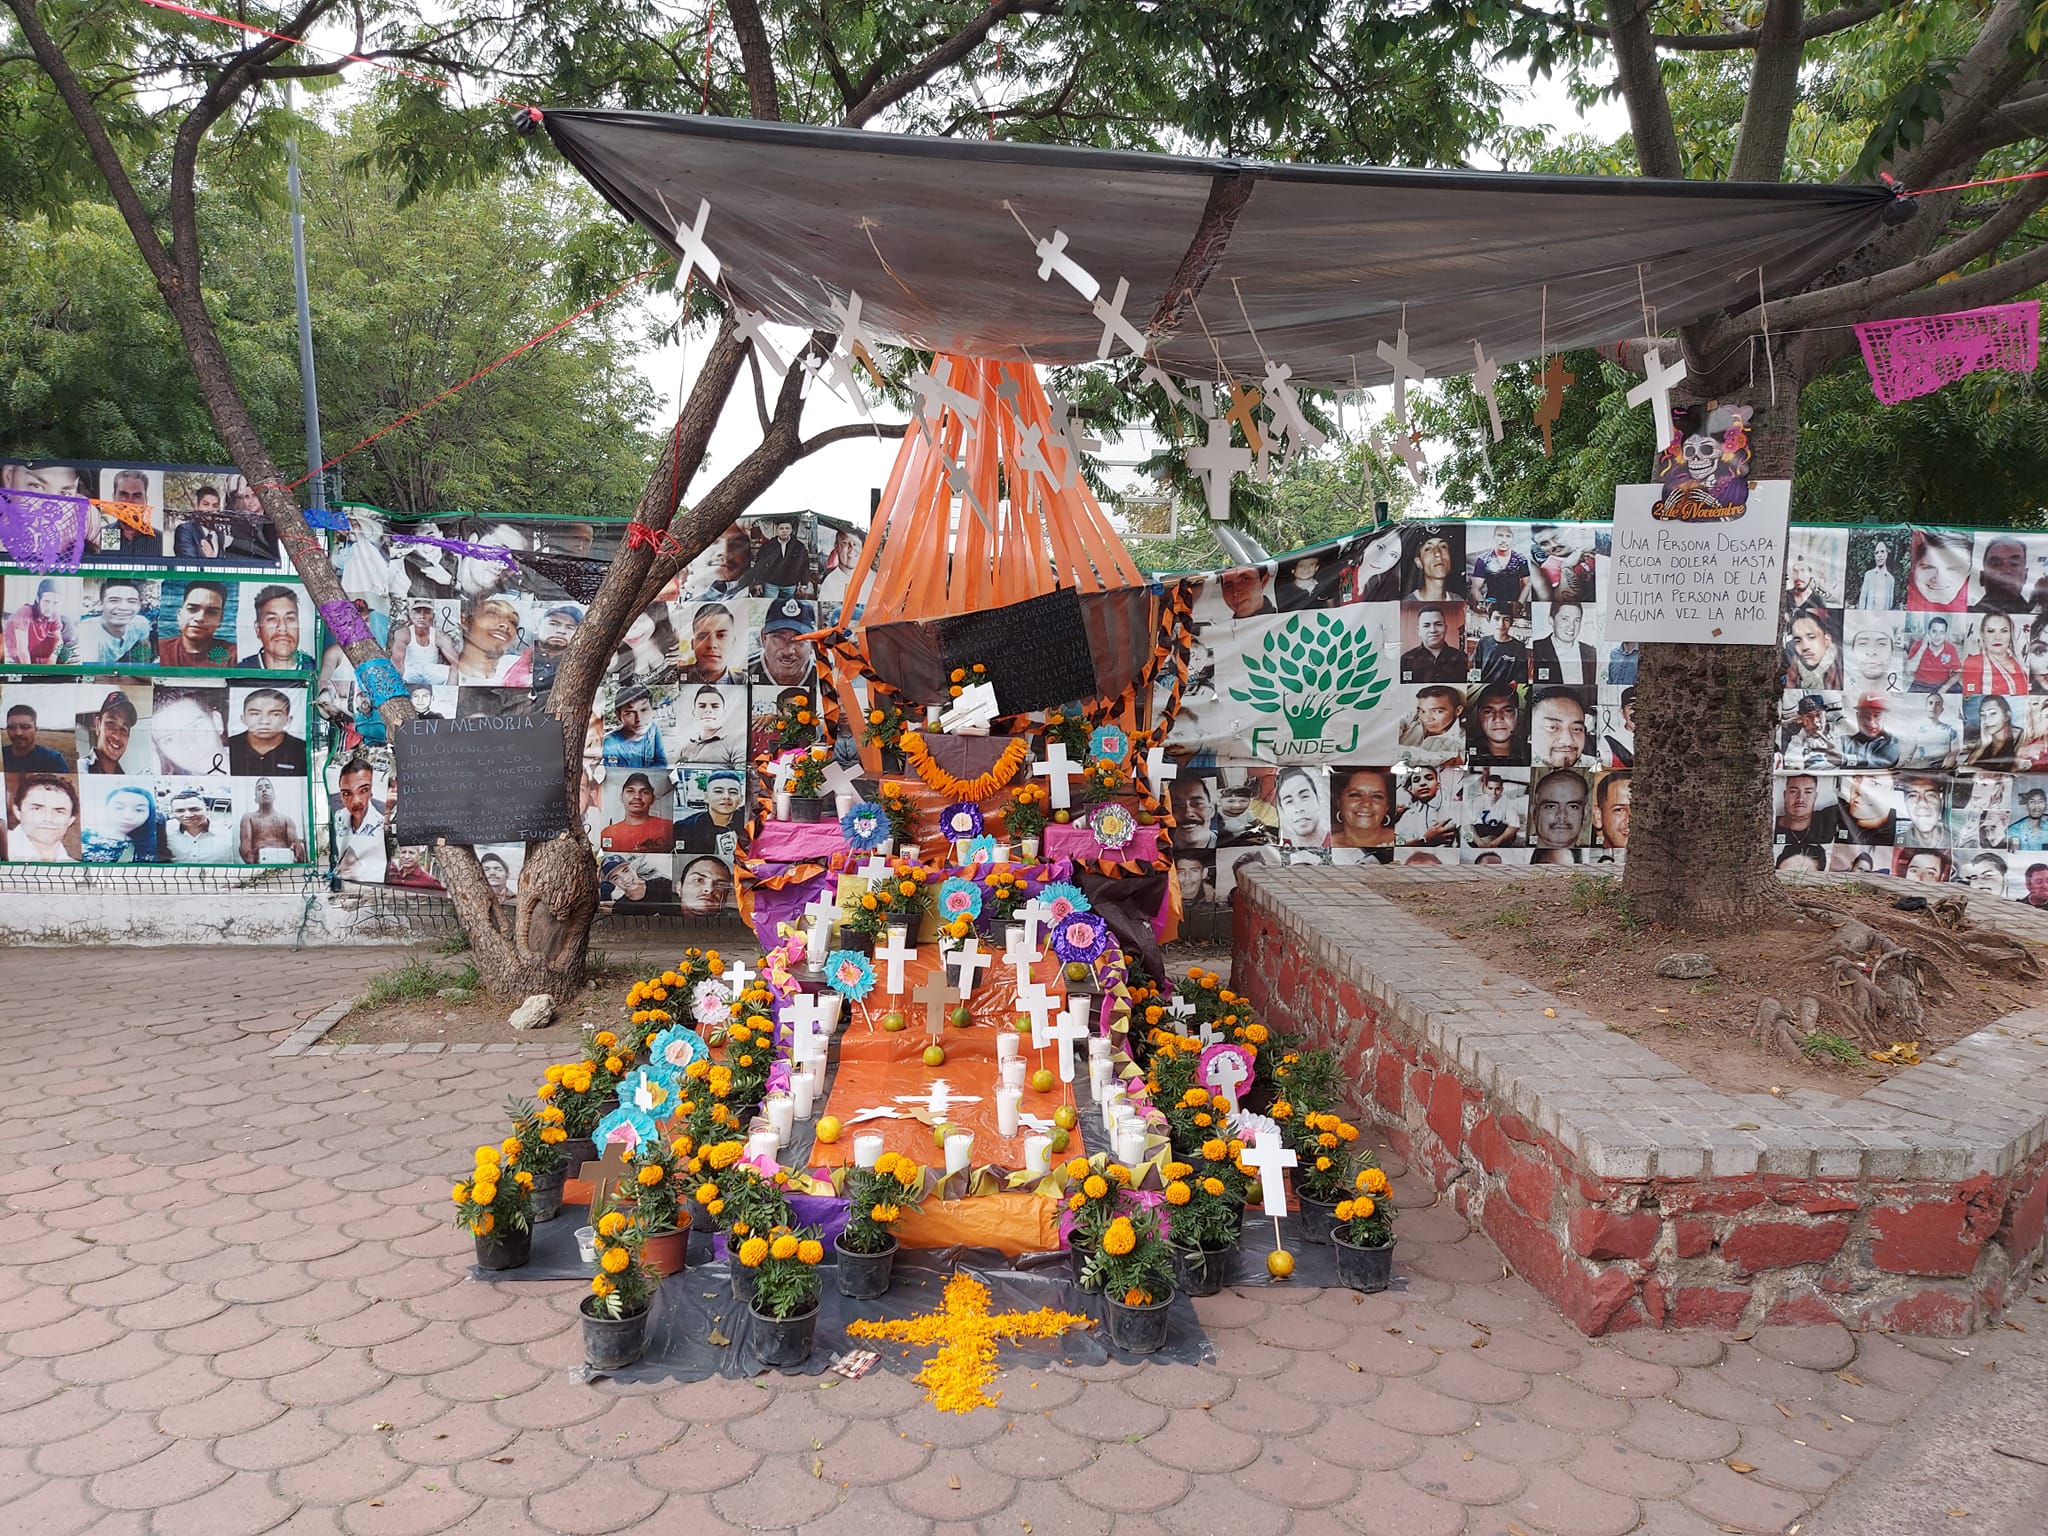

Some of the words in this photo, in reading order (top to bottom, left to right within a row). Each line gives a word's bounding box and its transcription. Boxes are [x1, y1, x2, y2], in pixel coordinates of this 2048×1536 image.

[1653, 502, 1664, 516] 2
[1665, 505, 1680, 517] de
[1681, 502, 1745, 520] Noviembre
[1621, 530, 1650, 551] UNA
[1657, 529, 1711, 551] PERSONA
[1717, 532, 1778, 552] DESAPA-
[1619, 555, 1662, 568] RECIDA
[1671, 553, 1718, 568] DOLERÁ
[1732, 555, 1775, 568] HASTA
[1617, 572, 1633, 585] EL
[1640, 572, 1686, 585] ULTIMO
[1693, 568, 1714, 584] DÍA
[1724, 571, 1740, 585] DE
[1750, 571, 1767, 585] LA
[1672, 589, 1730, 603] PERSONA
[1737, 589, 1766, 604] QUE
[1614, 607, 1665, 623] ALGUNA
[1676, 607, 1699, 619] VEZ
[1708, 607, 1724, 620] LA
[1734, 606, 1767, 621] AMO.
[1015, 615, 1082, 643] SILENCIOSOS
[413, 719, 440, 736] EN
[451, 715, 534, 734] MEMORIA
[1251, 723, 1360, 757] FUNDEJ
[478, 757, 495, 767] EN
[402, 784, 425, 796] DEL
[431, 781, 488, 793] ESTADO
[496, 779, 512, 789] DE
